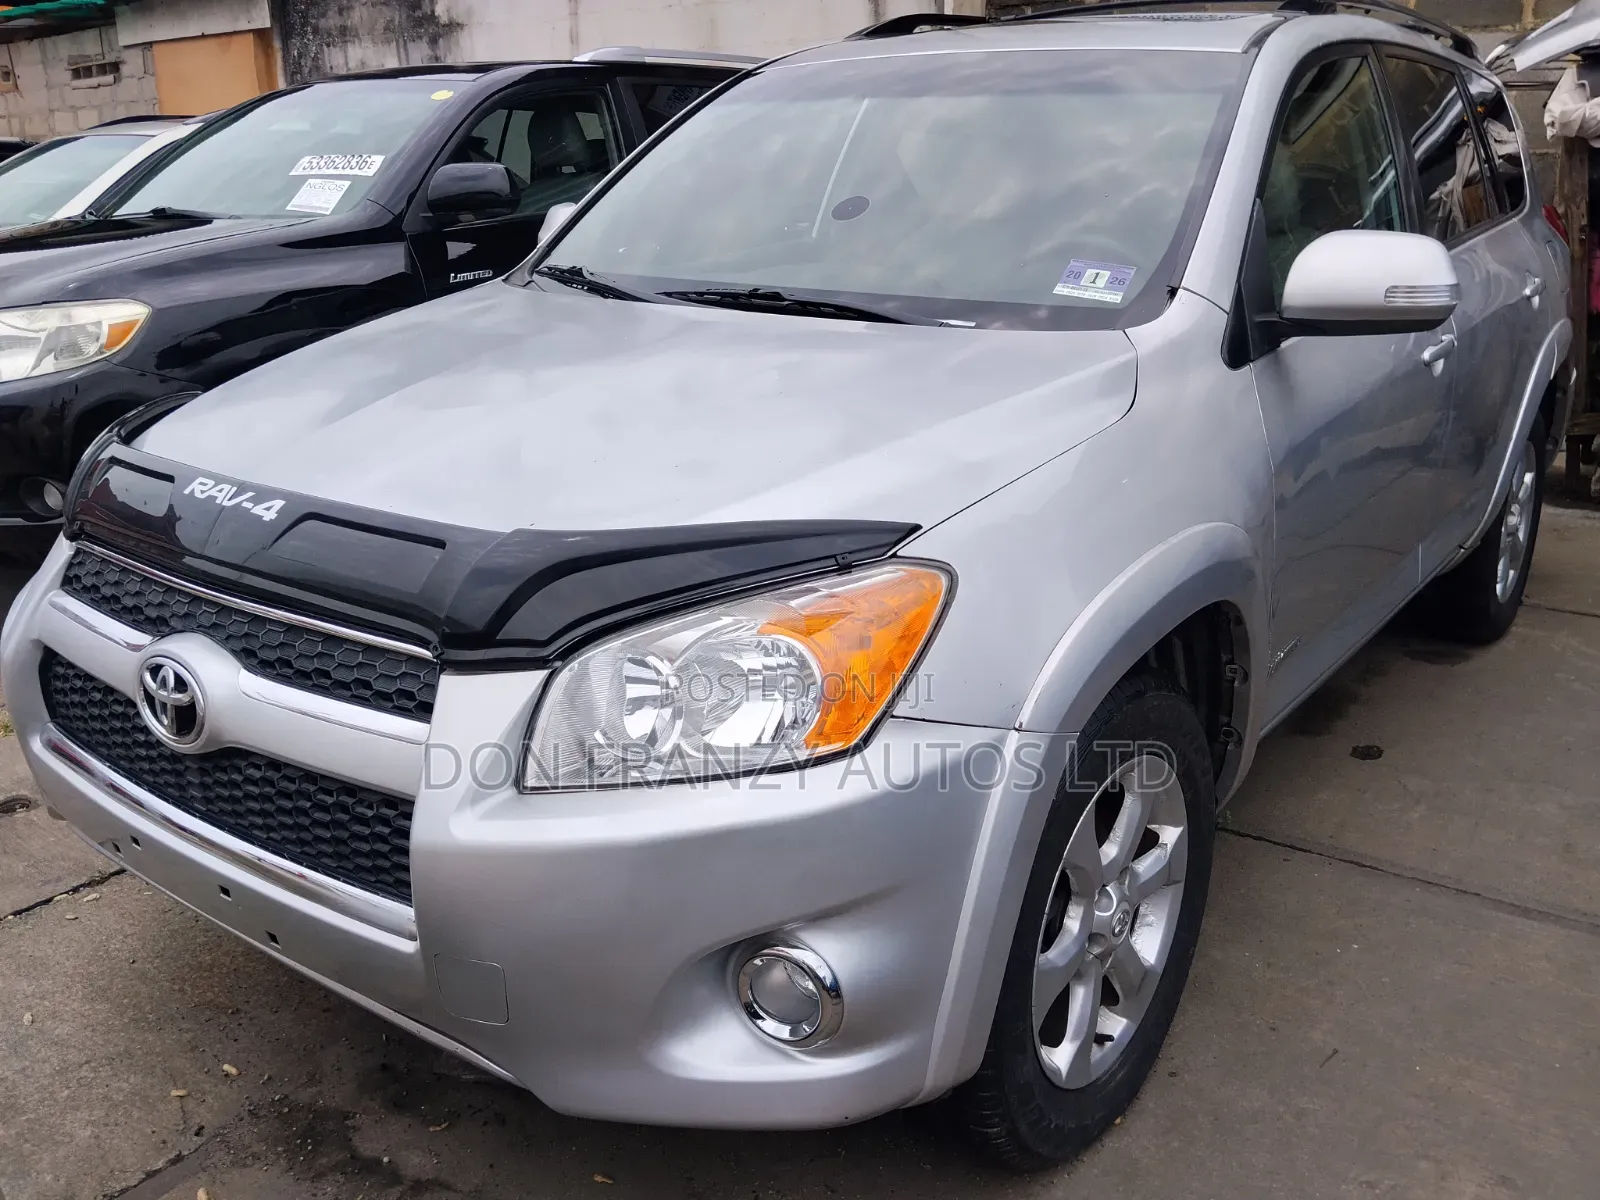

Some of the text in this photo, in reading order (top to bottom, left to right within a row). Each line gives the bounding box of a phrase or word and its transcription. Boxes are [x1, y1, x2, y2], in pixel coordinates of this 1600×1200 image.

[1066, 270, 1127, 286] 20 1 26
[183, 476, 287, 522] RAV-4
